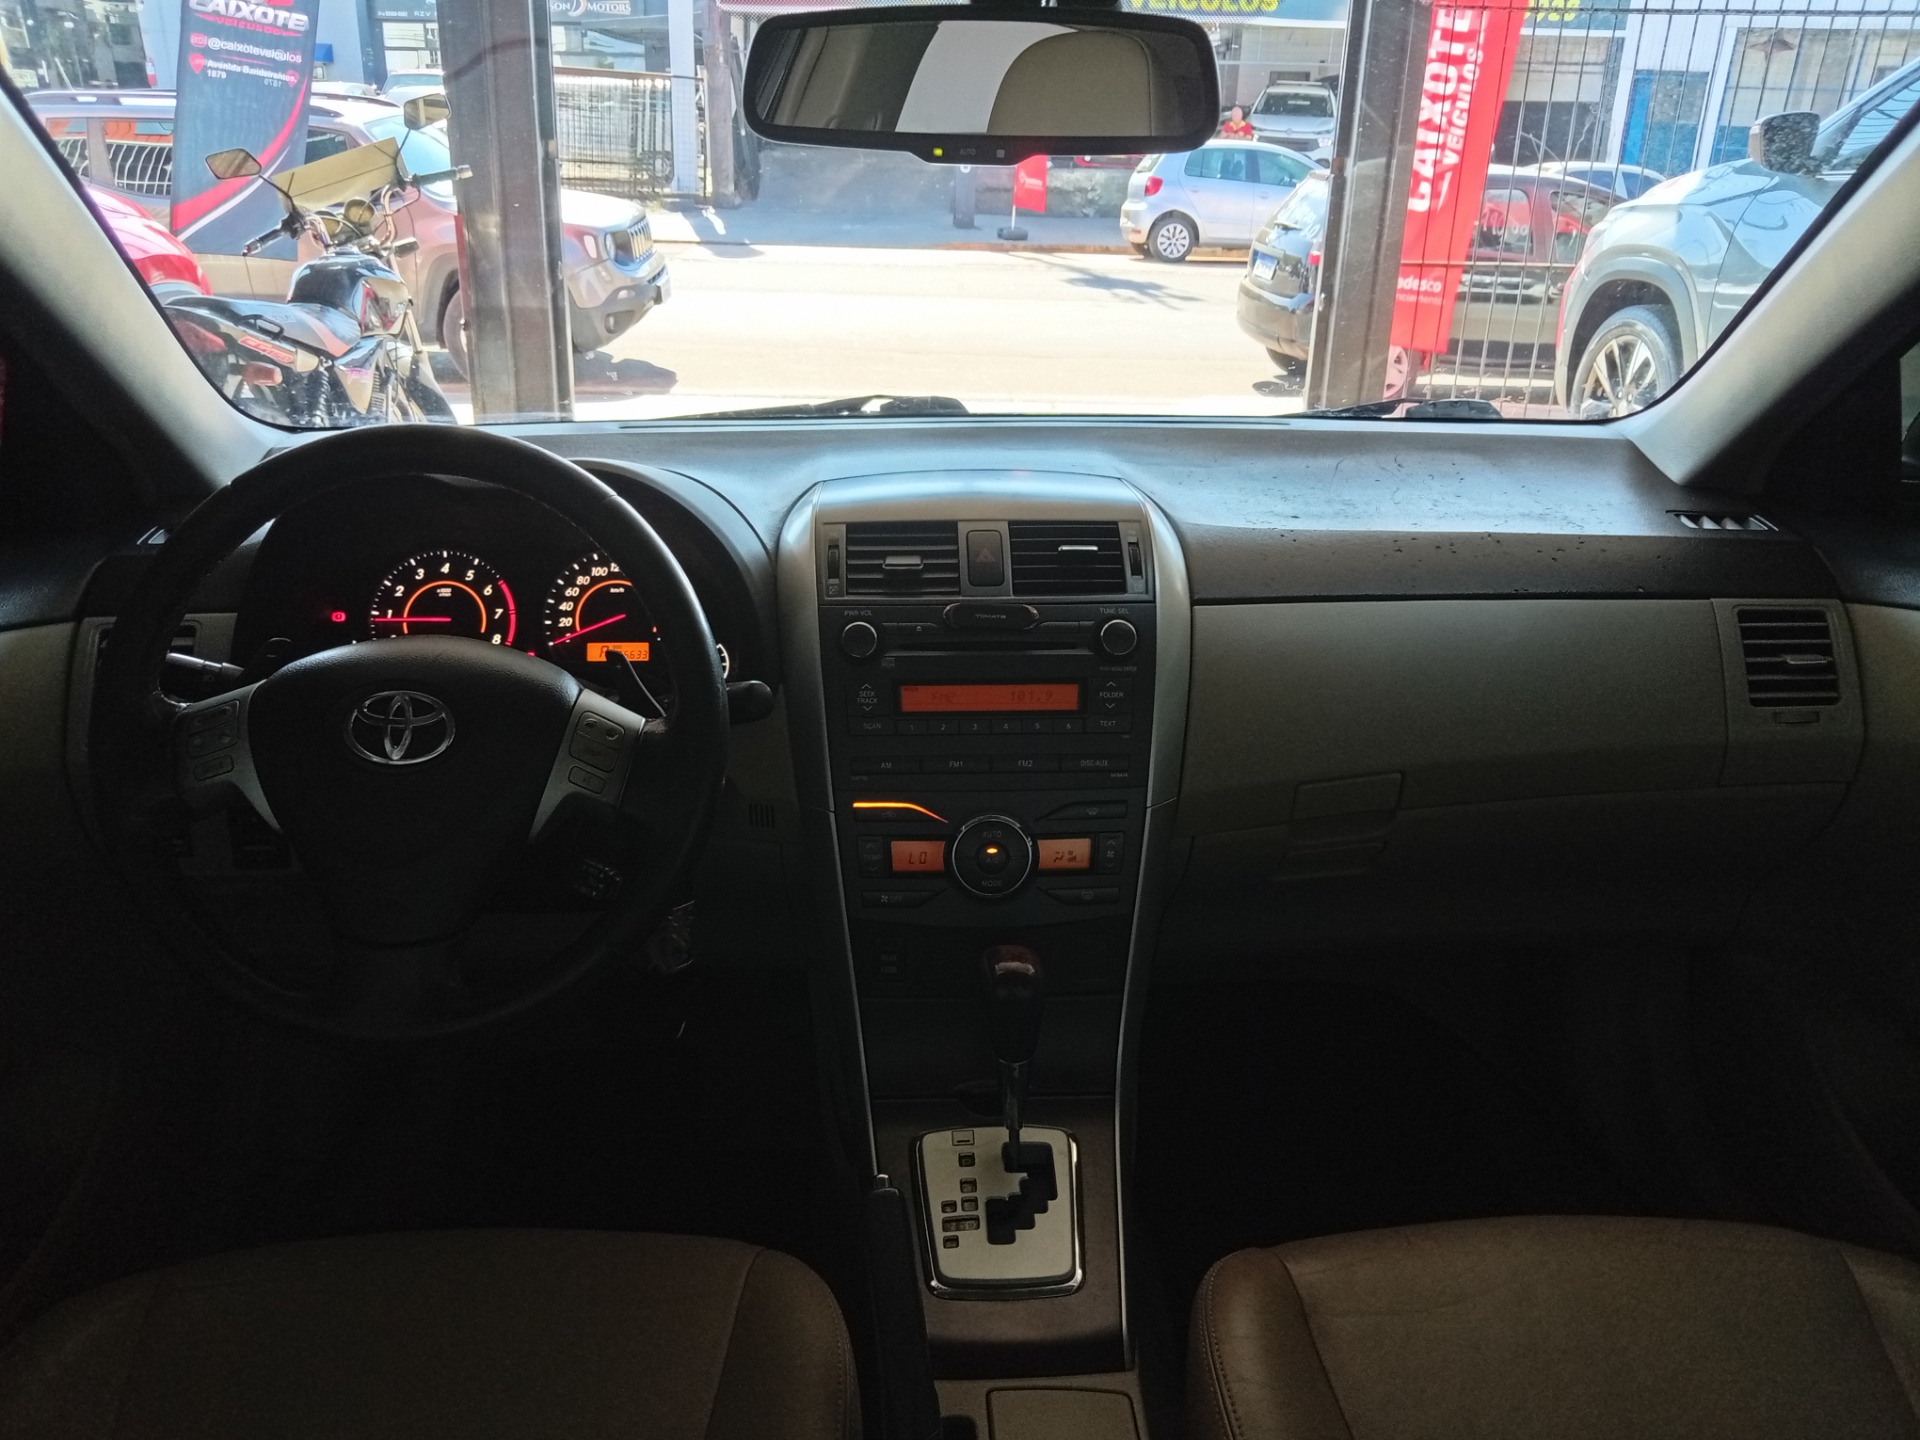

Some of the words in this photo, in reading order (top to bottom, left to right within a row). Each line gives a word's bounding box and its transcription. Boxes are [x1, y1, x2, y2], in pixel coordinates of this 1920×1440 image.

[587, 2, 631, 12] MOTORS
[188, 0, 310, 32] CAIXOTE
[1407, 7, 1474, 213] CAIXOTE
[440, 562, 450, 574] 4
[591, 567, 609, 577] 100
[415, 568, 425, 580] 3
[465, 570, 475, 581] 5
[576, 576, 591, 585] 80
[394, 585, 405, 597] 2
[483, 585, 493, 596] 6
[564, 587, 580, 597] 60
[558, 601, 574, 611] 40
[494, 608, 504, 620] 7
[557, 617, 573, 627] 20
[491, 633, 502, 645] 8
[1099, 691, 1125, 699] FOLDER
[880, 761, 892, 769] AM
